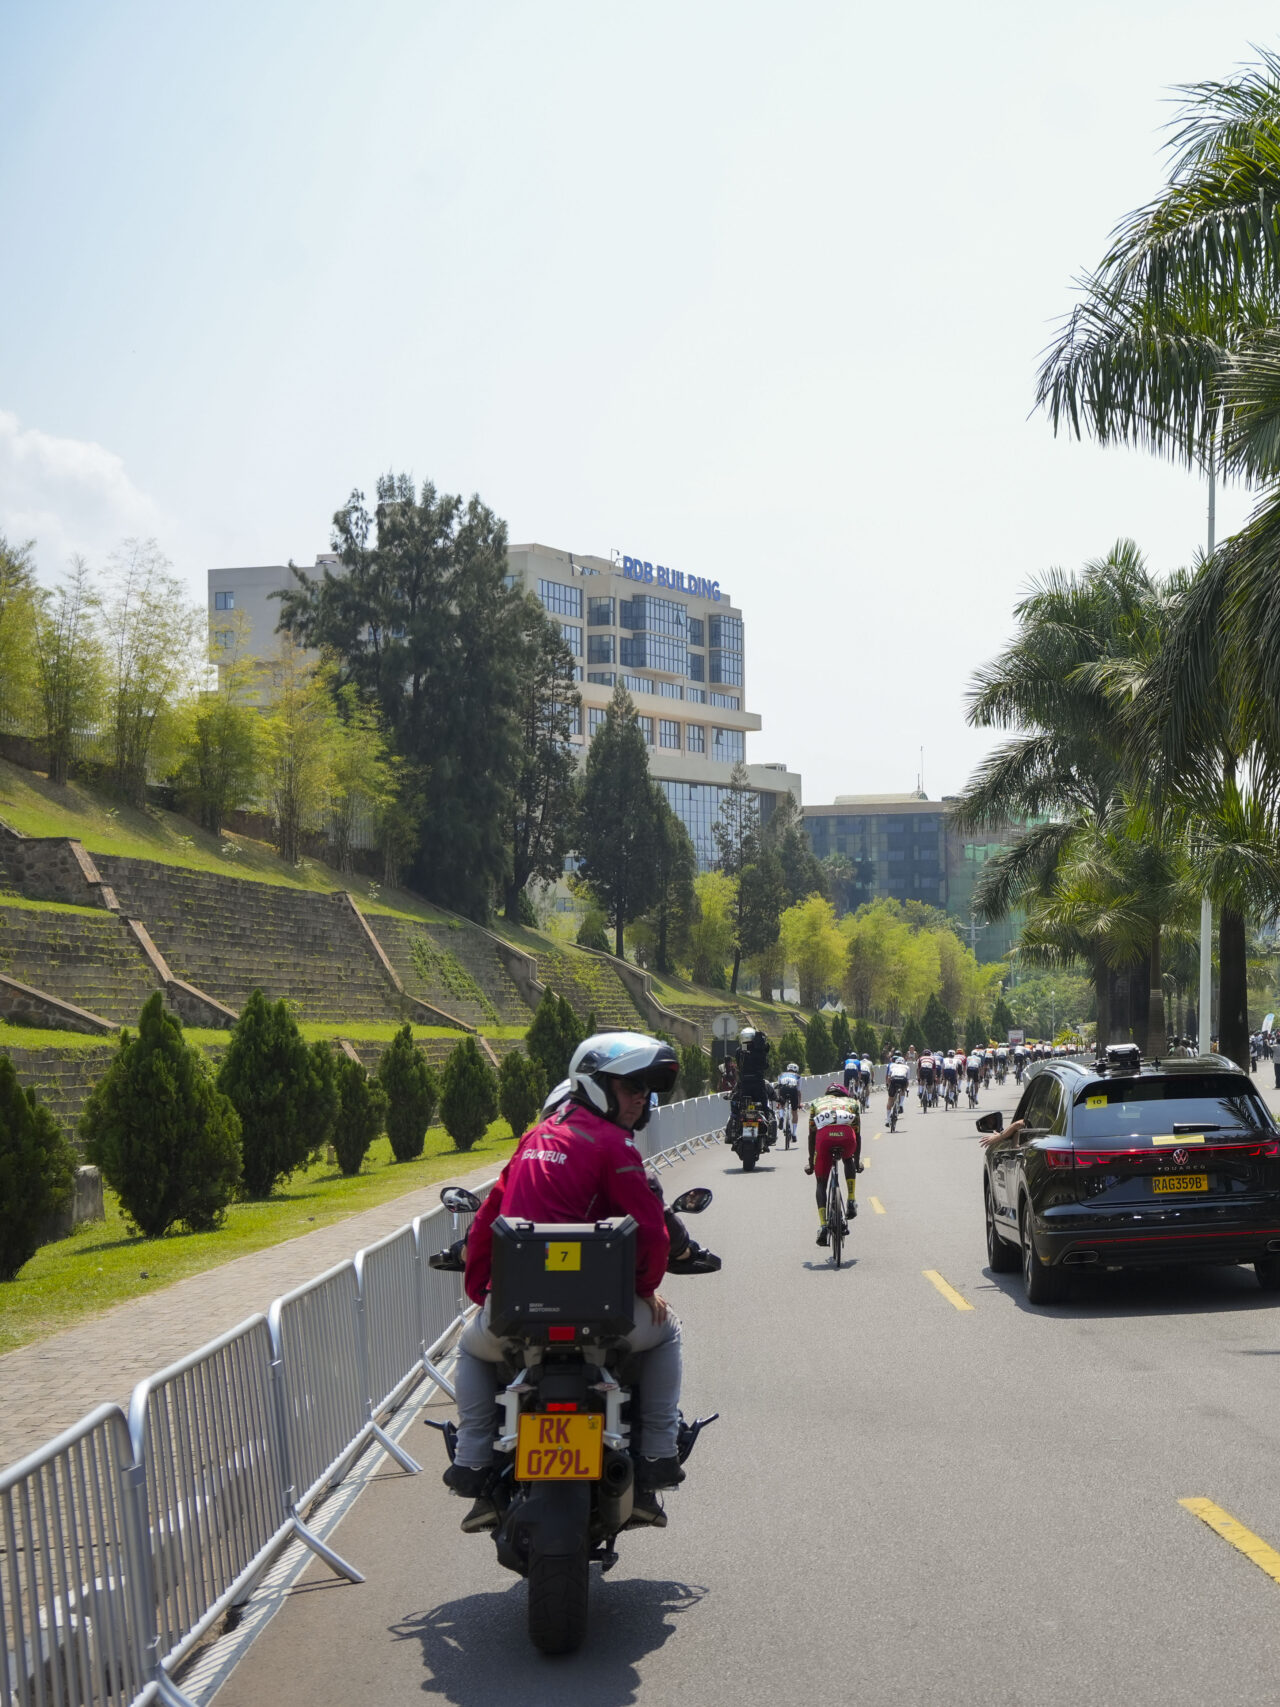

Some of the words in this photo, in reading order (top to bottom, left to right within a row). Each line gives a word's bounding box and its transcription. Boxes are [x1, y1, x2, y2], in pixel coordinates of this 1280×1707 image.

[623, 555, 654, 584] RDB
[657, 565, 721, 601] BUILDING
[1153, 1176, 1202, 1191] RAG359B
[560, 1251, 569, 1262] 7
[538, 1418, 572, 1444] RK
[527, 1449, 590, 1475] 079L
